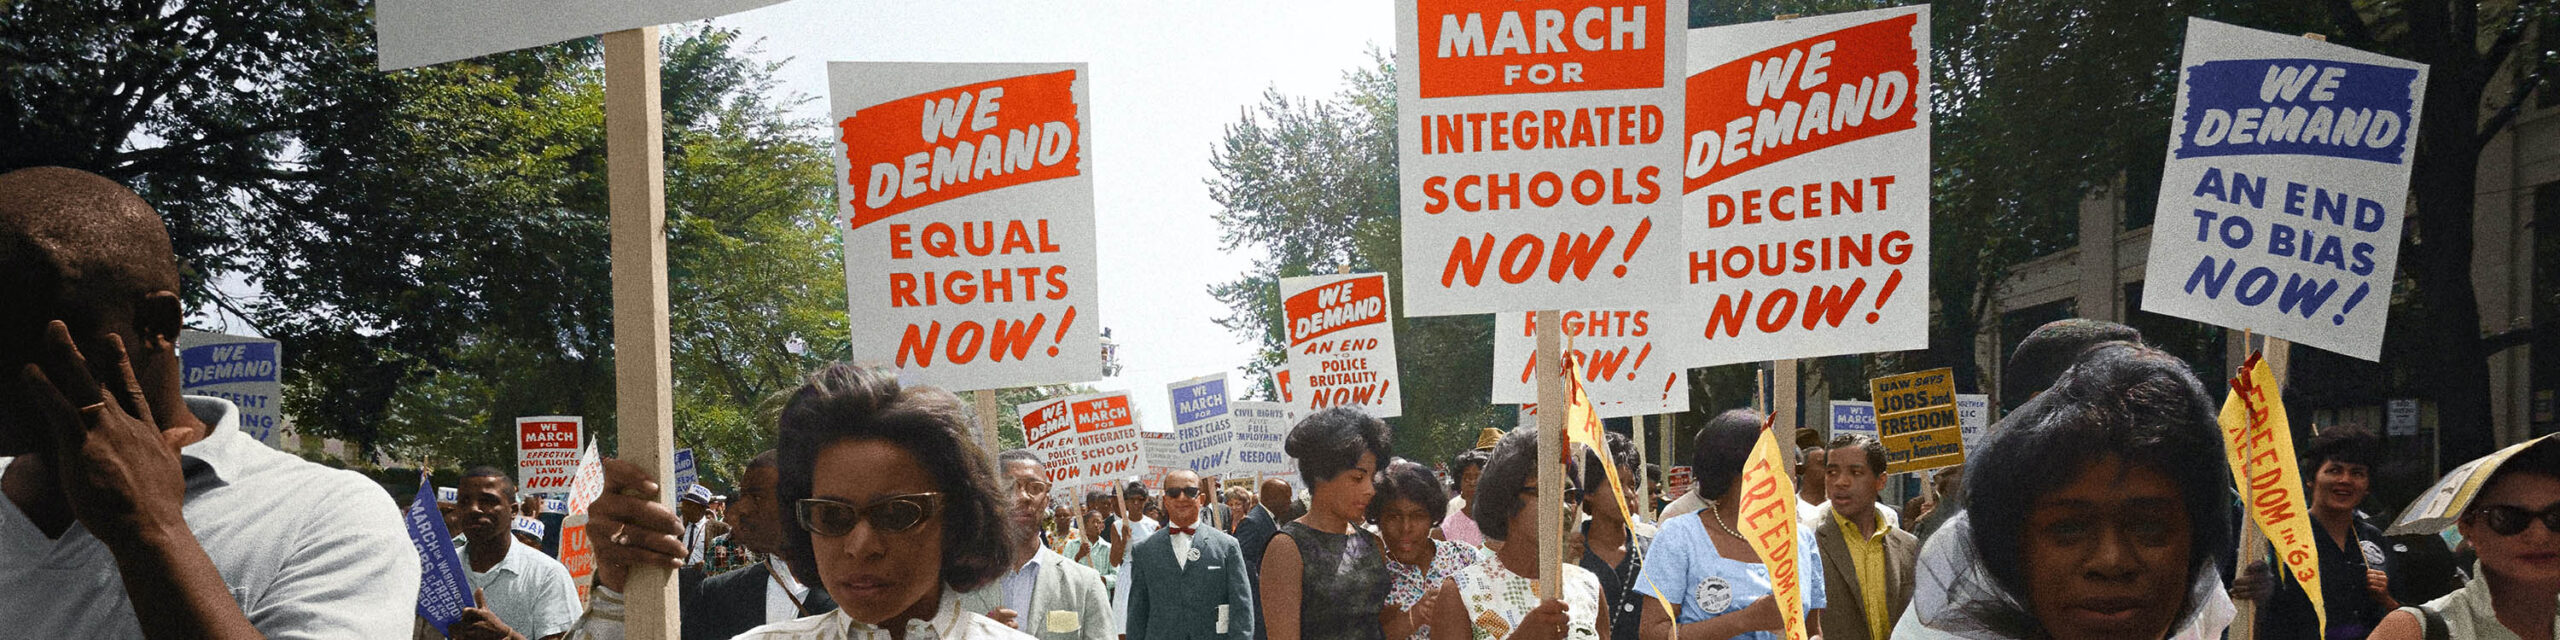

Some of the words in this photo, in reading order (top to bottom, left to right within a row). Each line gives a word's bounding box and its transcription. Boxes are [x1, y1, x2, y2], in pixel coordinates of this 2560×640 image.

[1437, 5, 1646, 58] MARCH
[1504, 62, 1584, 86] FOR
[1746, 40, 1836, 107] WE
[2260, 64, 2346, 102] WE
[921, 87, 1004, 143] WE
[1684, 71, 1908, 179] DEMAND
[2193, 106, 2401, 148] DEMAND
[1420, 105, 1664, 155] INTEGRATED
[866, 121, 1072, 209] DEMAND
[1423, 165, 1661, 215] SCHOOLS
[1707, 175, 1895, 228] DECENT
[2193, 167, 2267, 209] AN
[2284, 182, 2385, 233] END
[890, 219, 1060, 259] EQUAL
[2193, 209, 2253, 249] TO
[2268, 223, 2375, 276] BIAS
[1441, 216, 1652, 288] NOW!
[1689, 230, 1914, 284] HOUSING
[890, 265, 1068, 307] RIGHTS
[1318, 282, 1354, 308] WE
[2184, 255, 2370, 326] NOW!
[1704, 269, 1902, 340] NOW!
[1295, 296, 1381, 339] DEMAND
[1524, 310, 1649, 337] RGHTS
[895, 306, 1076, 368] NOW!
[1304, 341, 1333, 355] AN
[1340, 338, 1378, 351] END
[212, 345, 246, 363] WE
[1322, 358, 1367, 373] POLICE
[189, 360, 273, 384] DEMAND
[1310, 371, 1377, 387] BRUTALITY
[1192, 386, 1207, 397] WE
[1310, 380, 1389, 410] NOW!
[1880, 380, 1910, 391] UAW
[1042, 402, 1064, 421] WE
[1092, 400, 1109, 410] WE
[1180, 393, 1222, 414] MARCH
[1234, 409, 1253, 417] CIVIL
[1257, 409, 1283, 418] RIGHTS
[1879, 390, 1928, 414] JOBS
[1931, 390, 1951, 405] and
[1078, 407, 1127, 425] MARCH
[1095, 421, 1114, 429] FOR
[1195, 410, 1210, 419] FOR
[1837, 415, 1875, 424] MARCH
[1881, 409, 1955, 436] FREEDOM
[525, 432, 573, 442] MARCH
[540, 423, 557, 431] WE
[1078, 428, 1136, 446] INTEGRATED
[1179, 424, 1203, 440] FIRST
[1205, 419, 1231, 434] CLASS
[1248, 425, 1268, 433] FULL
[1909, 434, 1932, 443] FOR
[1037, 441, 1054, 451] AN
[1059, 437, 1073, 447] EN
[1048, 448, 1077, 459] POLICE
[1081, 442, 1139, 461] SCHOOLS
[1179, 431, 1233, 454] CITIZENSHIP
[520, 459, 543, 467] CIVIL
[527, 451, 576, 459] EFFECTIVE
[1090, 454, 1138, 477] NOW!
[1190, 446, 1232, 472] NOW!
[1240, 451, 1282, 464] REEDOM
[526, 475, 576, 488] NOW!
[411, 499, 439, 551] MARCH
[1740, 458, 1796, 597] FREEDOM
[2280, 528, 2296, 546] IN
[2287, 544, 2315, 583] '63
